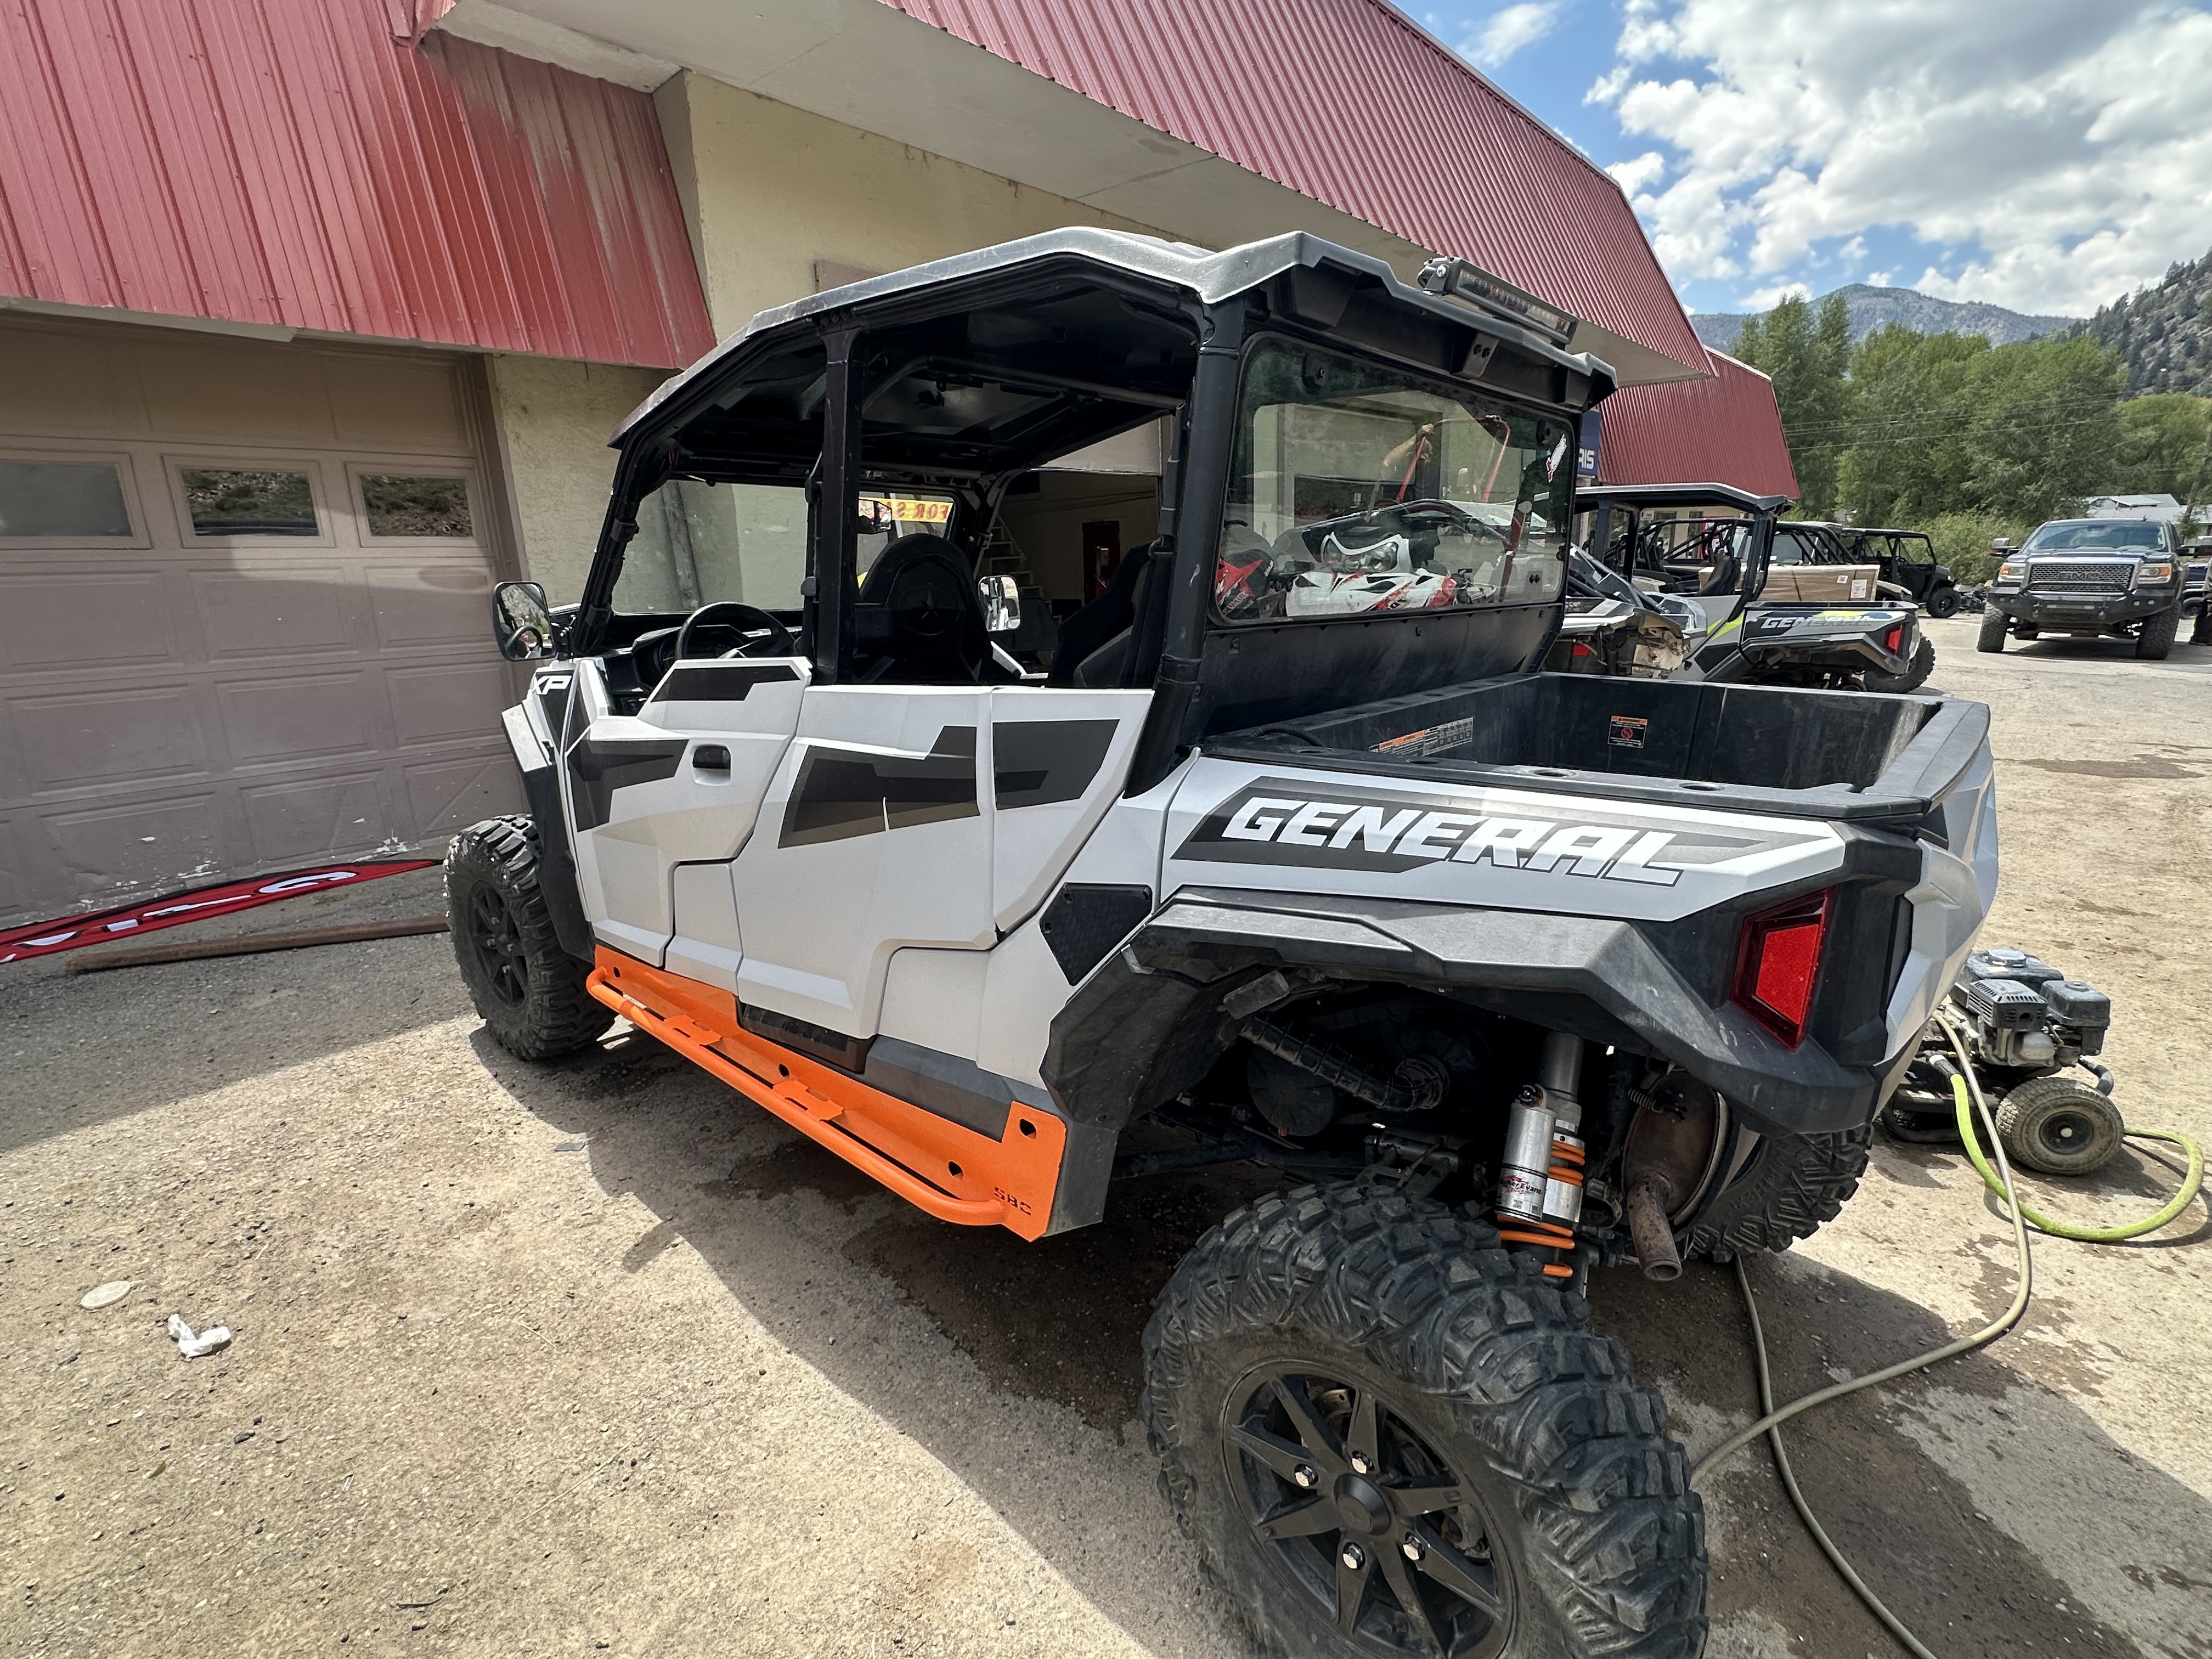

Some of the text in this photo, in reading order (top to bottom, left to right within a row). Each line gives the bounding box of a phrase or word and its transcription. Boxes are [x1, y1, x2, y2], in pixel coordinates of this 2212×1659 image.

[2059, 571, 2100, 580] GMC
[1760, 616, 1872, 629] GENERAL
[532, 675, 573, 695] XP
[1221, 797, 1685, 888] GENERAL
